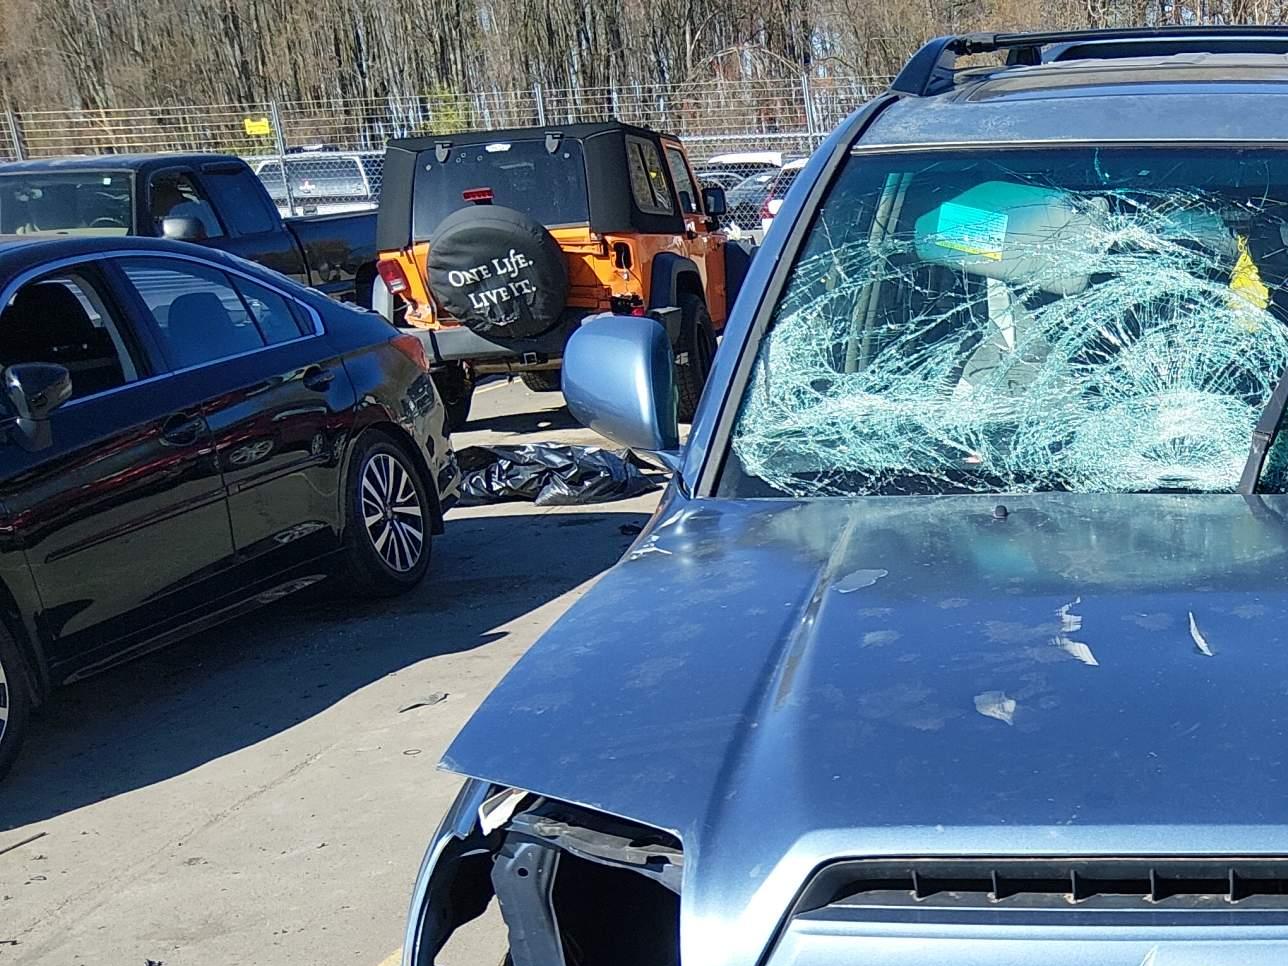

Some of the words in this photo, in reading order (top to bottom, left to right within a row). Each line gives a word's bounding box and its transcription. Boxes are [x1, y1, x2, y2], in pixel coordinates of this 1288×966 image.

[448, 265, 492, 287] ONE
[468, 287, 511, 309] LIVE
[508, 279, 536, 297] IT.
